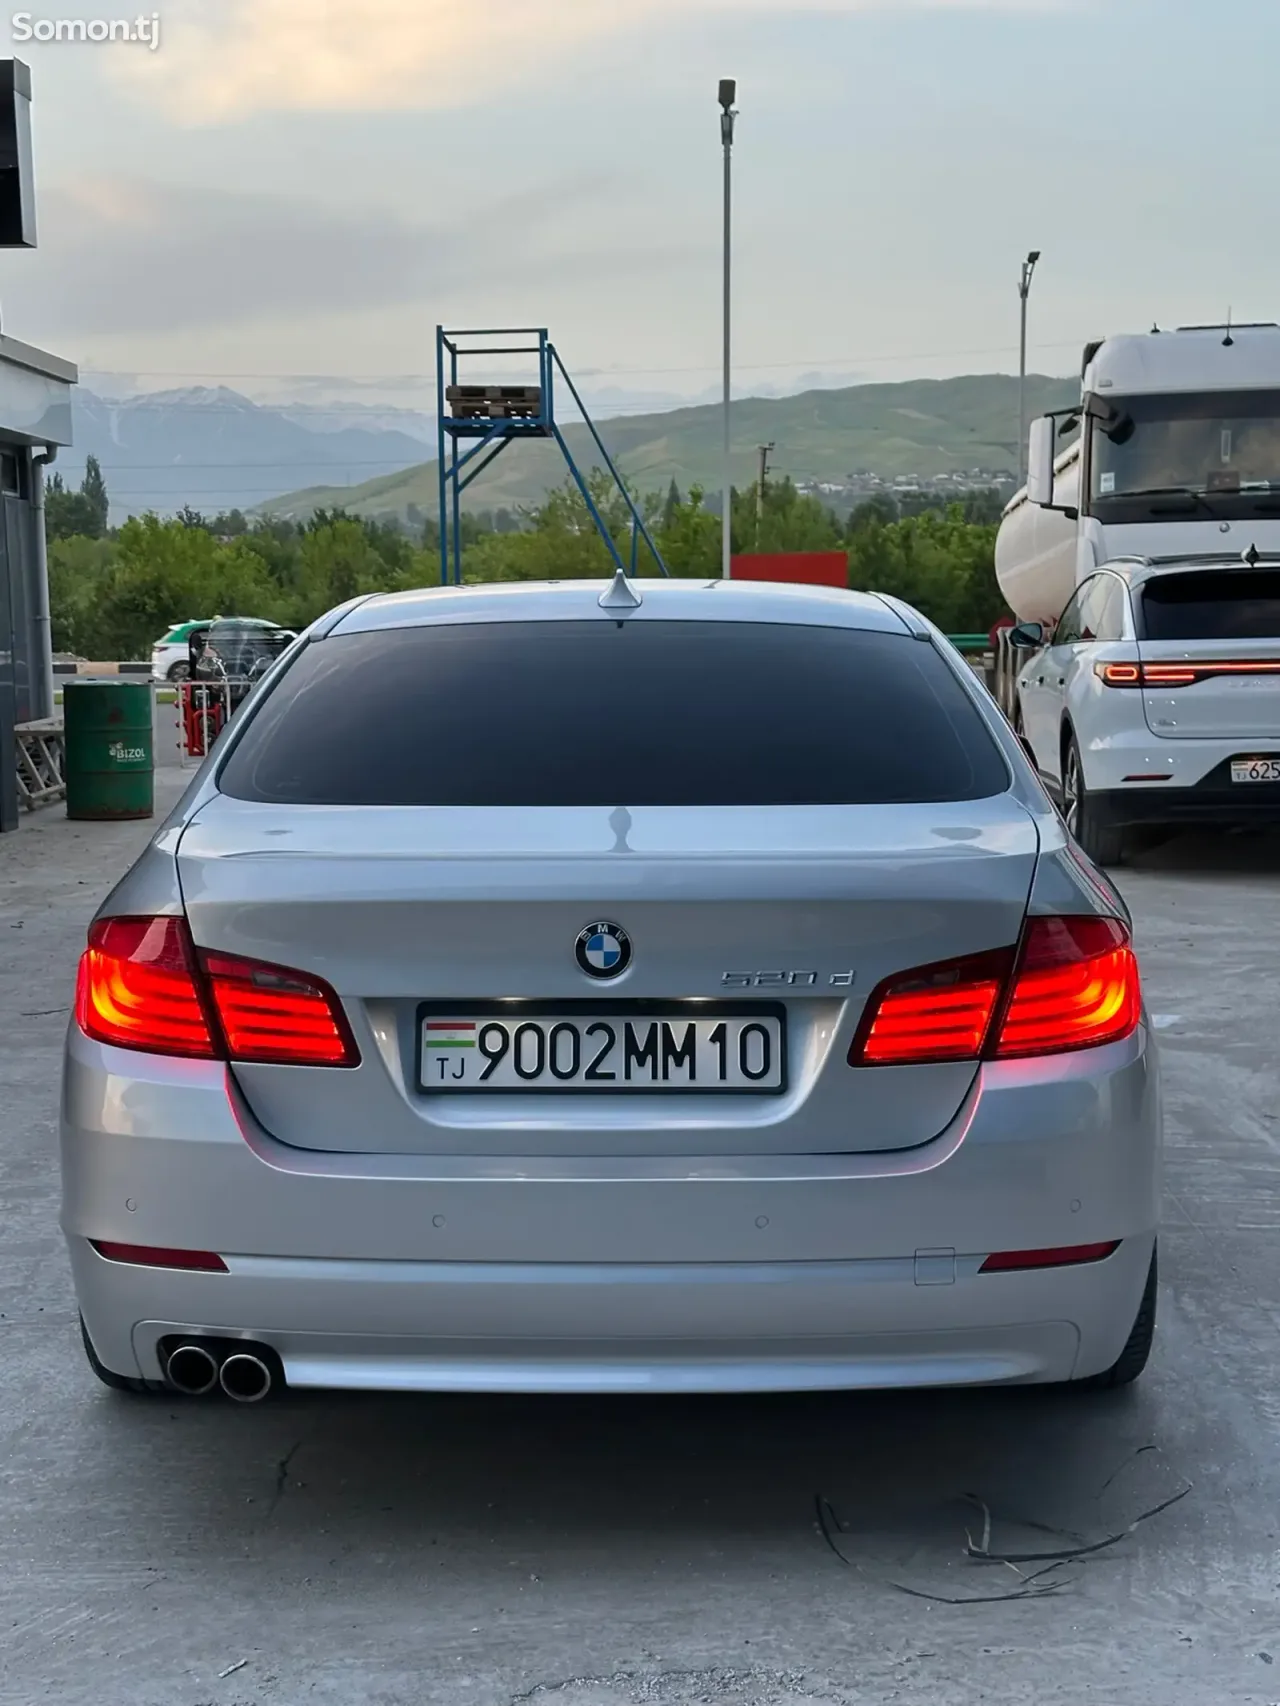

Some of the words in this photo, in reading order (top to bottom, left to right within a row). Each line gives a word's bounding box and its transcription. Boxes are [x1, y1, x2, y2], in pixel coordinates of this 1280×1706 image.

[117, 748, 145, 759] BIZOL
[580, 924, 627, 943] BMW
[436, 1057, 465, 1080] TJ
